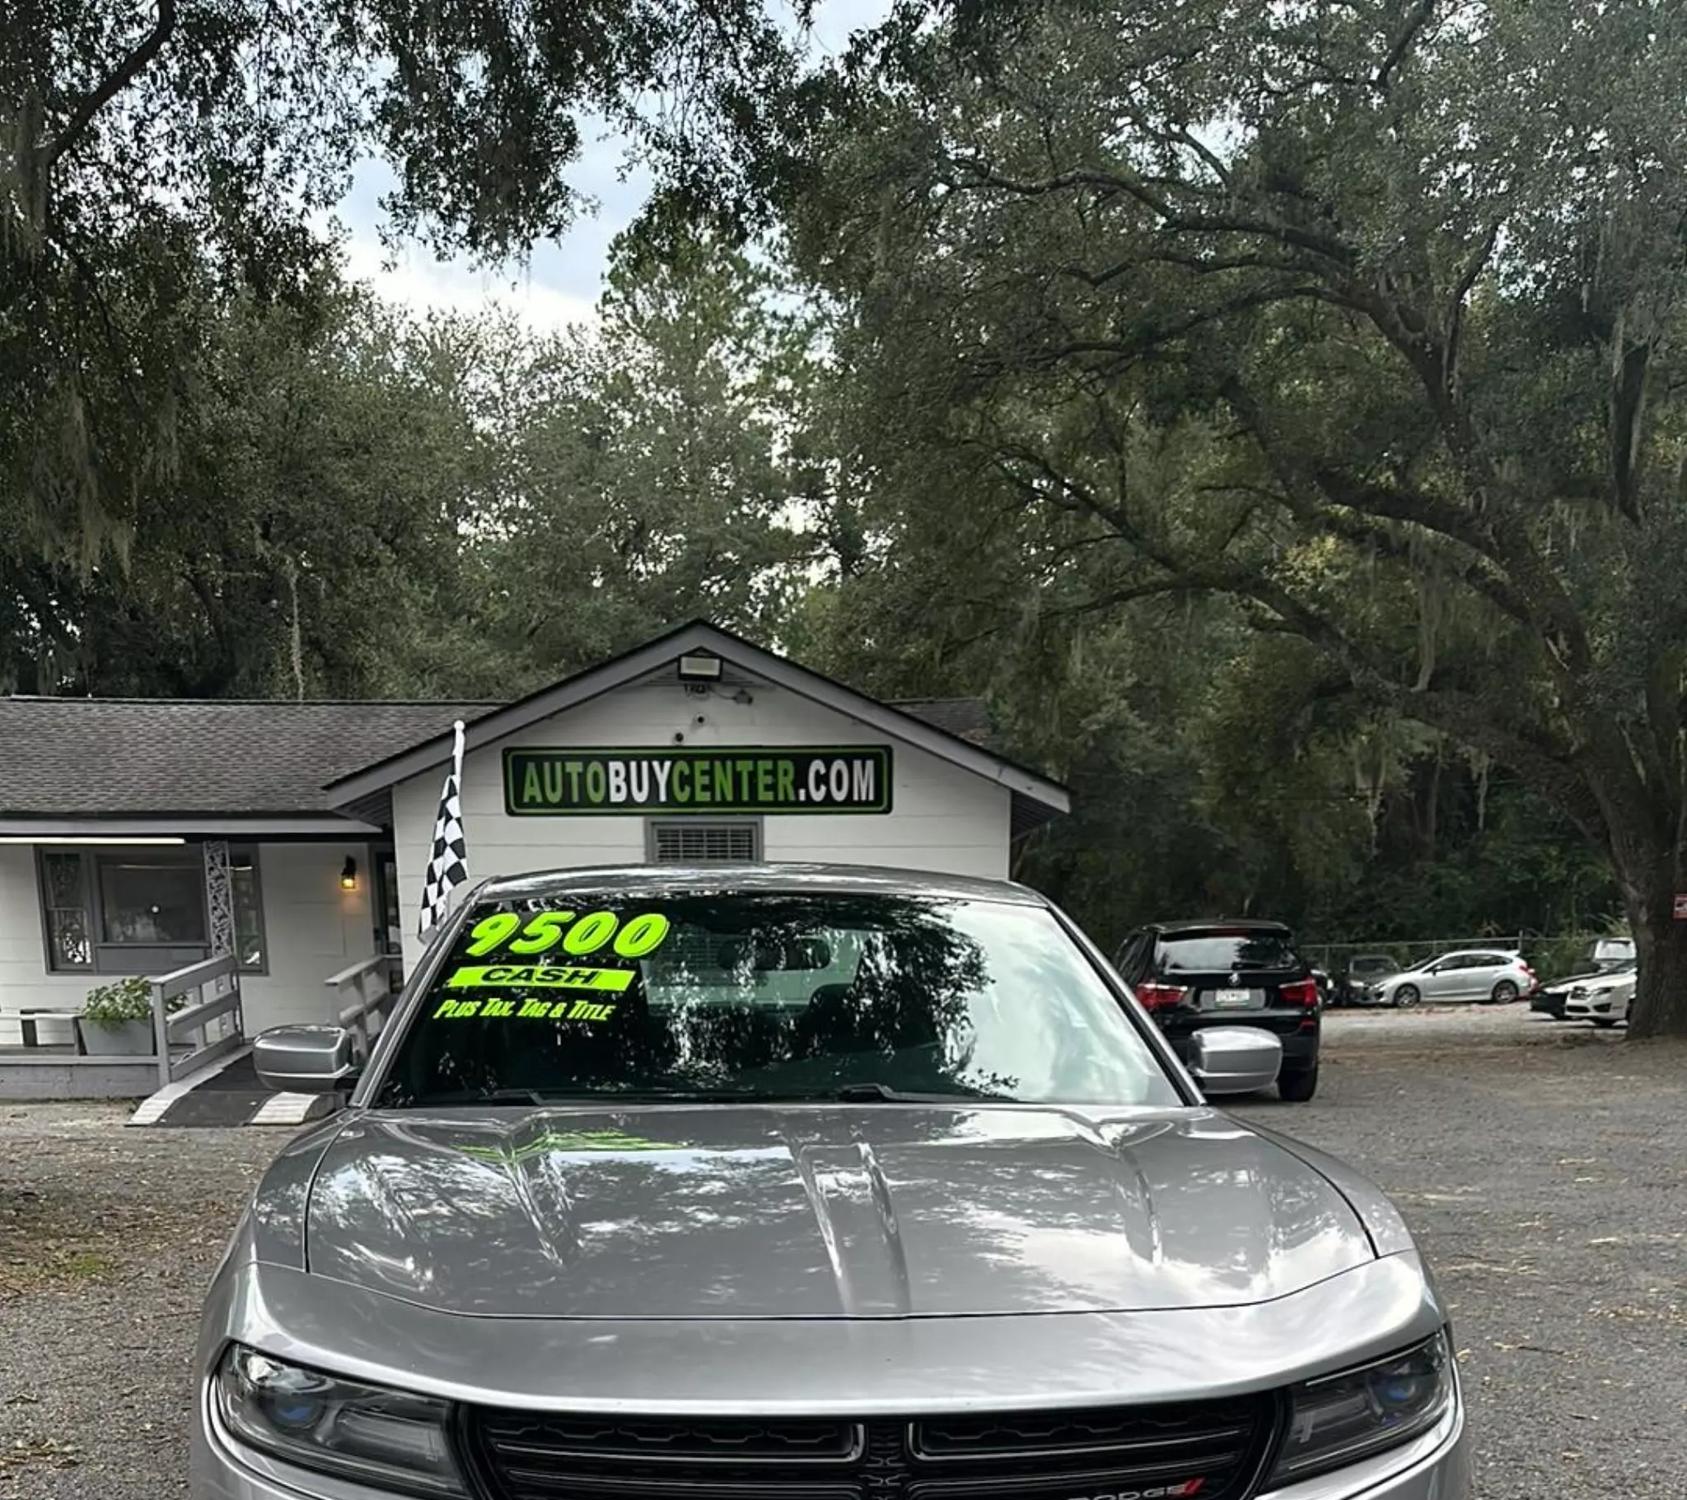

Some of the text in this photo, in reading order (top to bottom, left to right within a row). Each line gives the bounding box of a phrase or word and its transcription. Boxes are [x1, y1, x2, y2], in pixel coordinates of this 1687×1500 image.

[522, 759, 876, 803] AUTOBUYCENTER.COM
[465, 910, 671, 958] 9500
[480, 967, 600, 985] CASH
[548, 1002, 568, 1018] &
